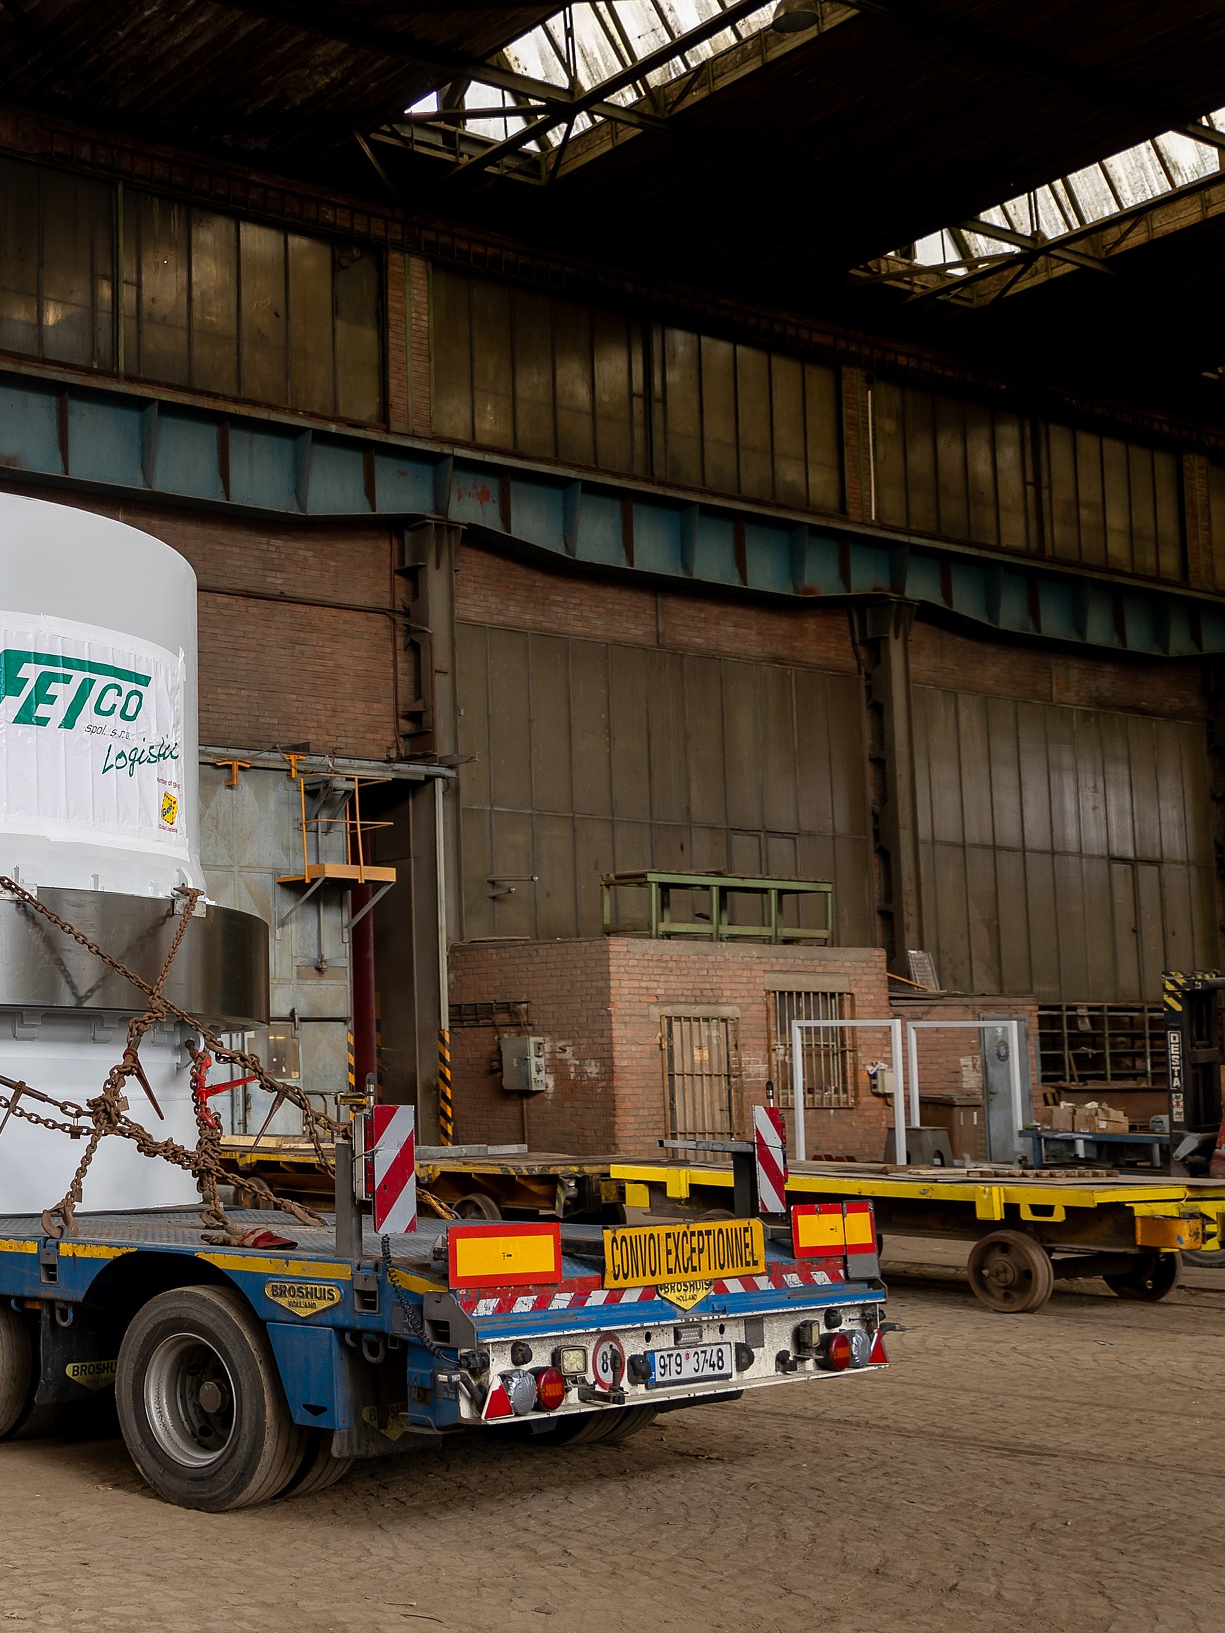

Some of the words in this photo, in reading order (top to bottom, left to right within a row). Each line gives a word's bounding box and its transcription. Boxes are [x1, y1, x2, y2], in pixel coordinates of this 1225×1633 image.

[1170, 1033, 1181, 1088] DESTA
[610, 1232, 662, 1281] CONVOI
[666, 1225, 759, 1275] EXCEPTIONNEL
[271, 1284, 336, 1301] BROSHUIS
[664, 1279, 710, 1295] BROSHUIS
[676, 1293, 698, 1303] HOLLAND
[72, 1361, 116, 1377] BROSHU
[658, 1352, 683, 1377] 9T9
[692, 1347, 725, 1373] 3748
